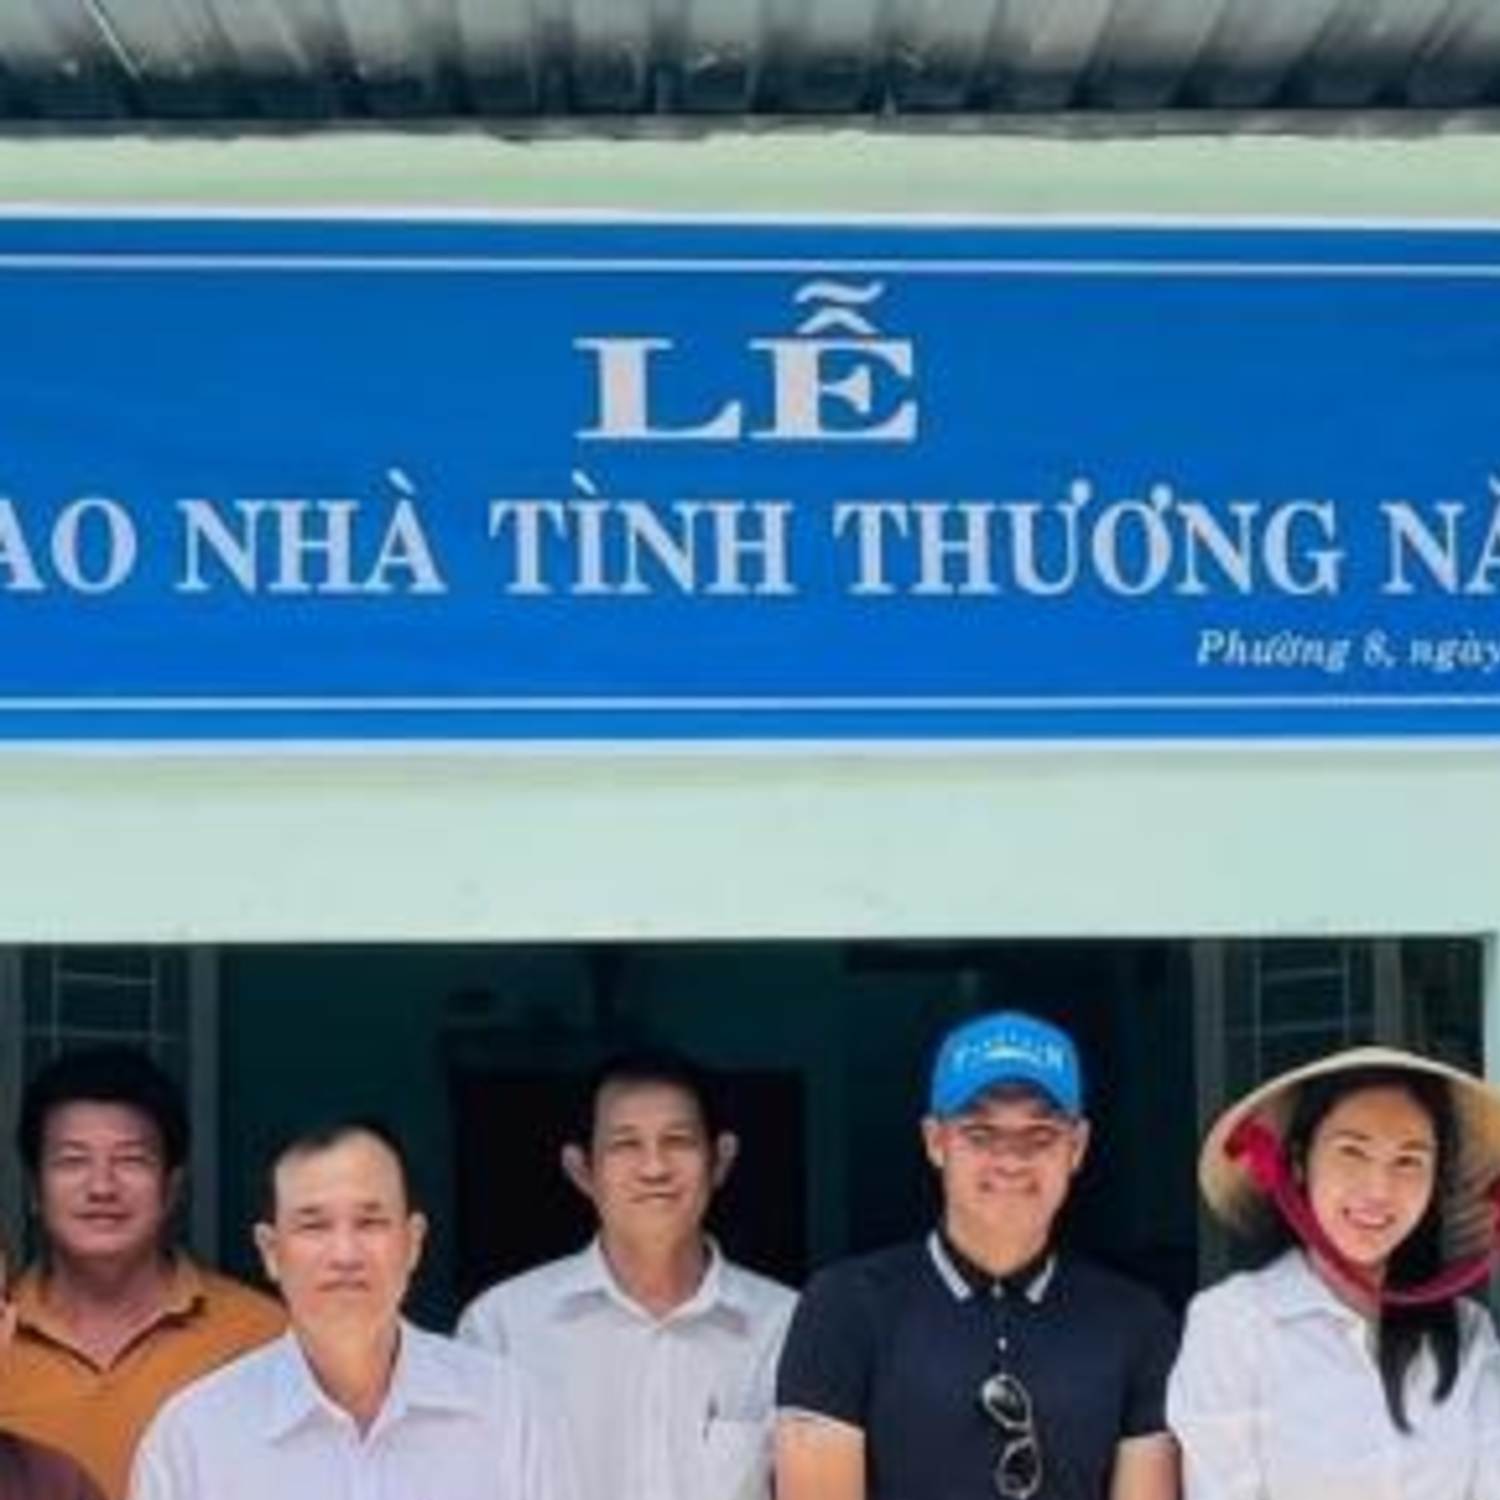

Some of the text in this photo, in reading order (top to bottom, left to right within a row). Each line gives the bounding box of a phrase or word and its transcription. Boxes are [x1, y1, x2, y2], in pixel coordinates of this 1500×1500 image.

[575, 282, 918, 440] LỄ
[174, 468, 446, 592] NHÀ
[488, 471, 794, 594] TÌNH
[834, 480, 1343, 596] THƯƠNG
[1362, 629, 1398, 668] 8,
